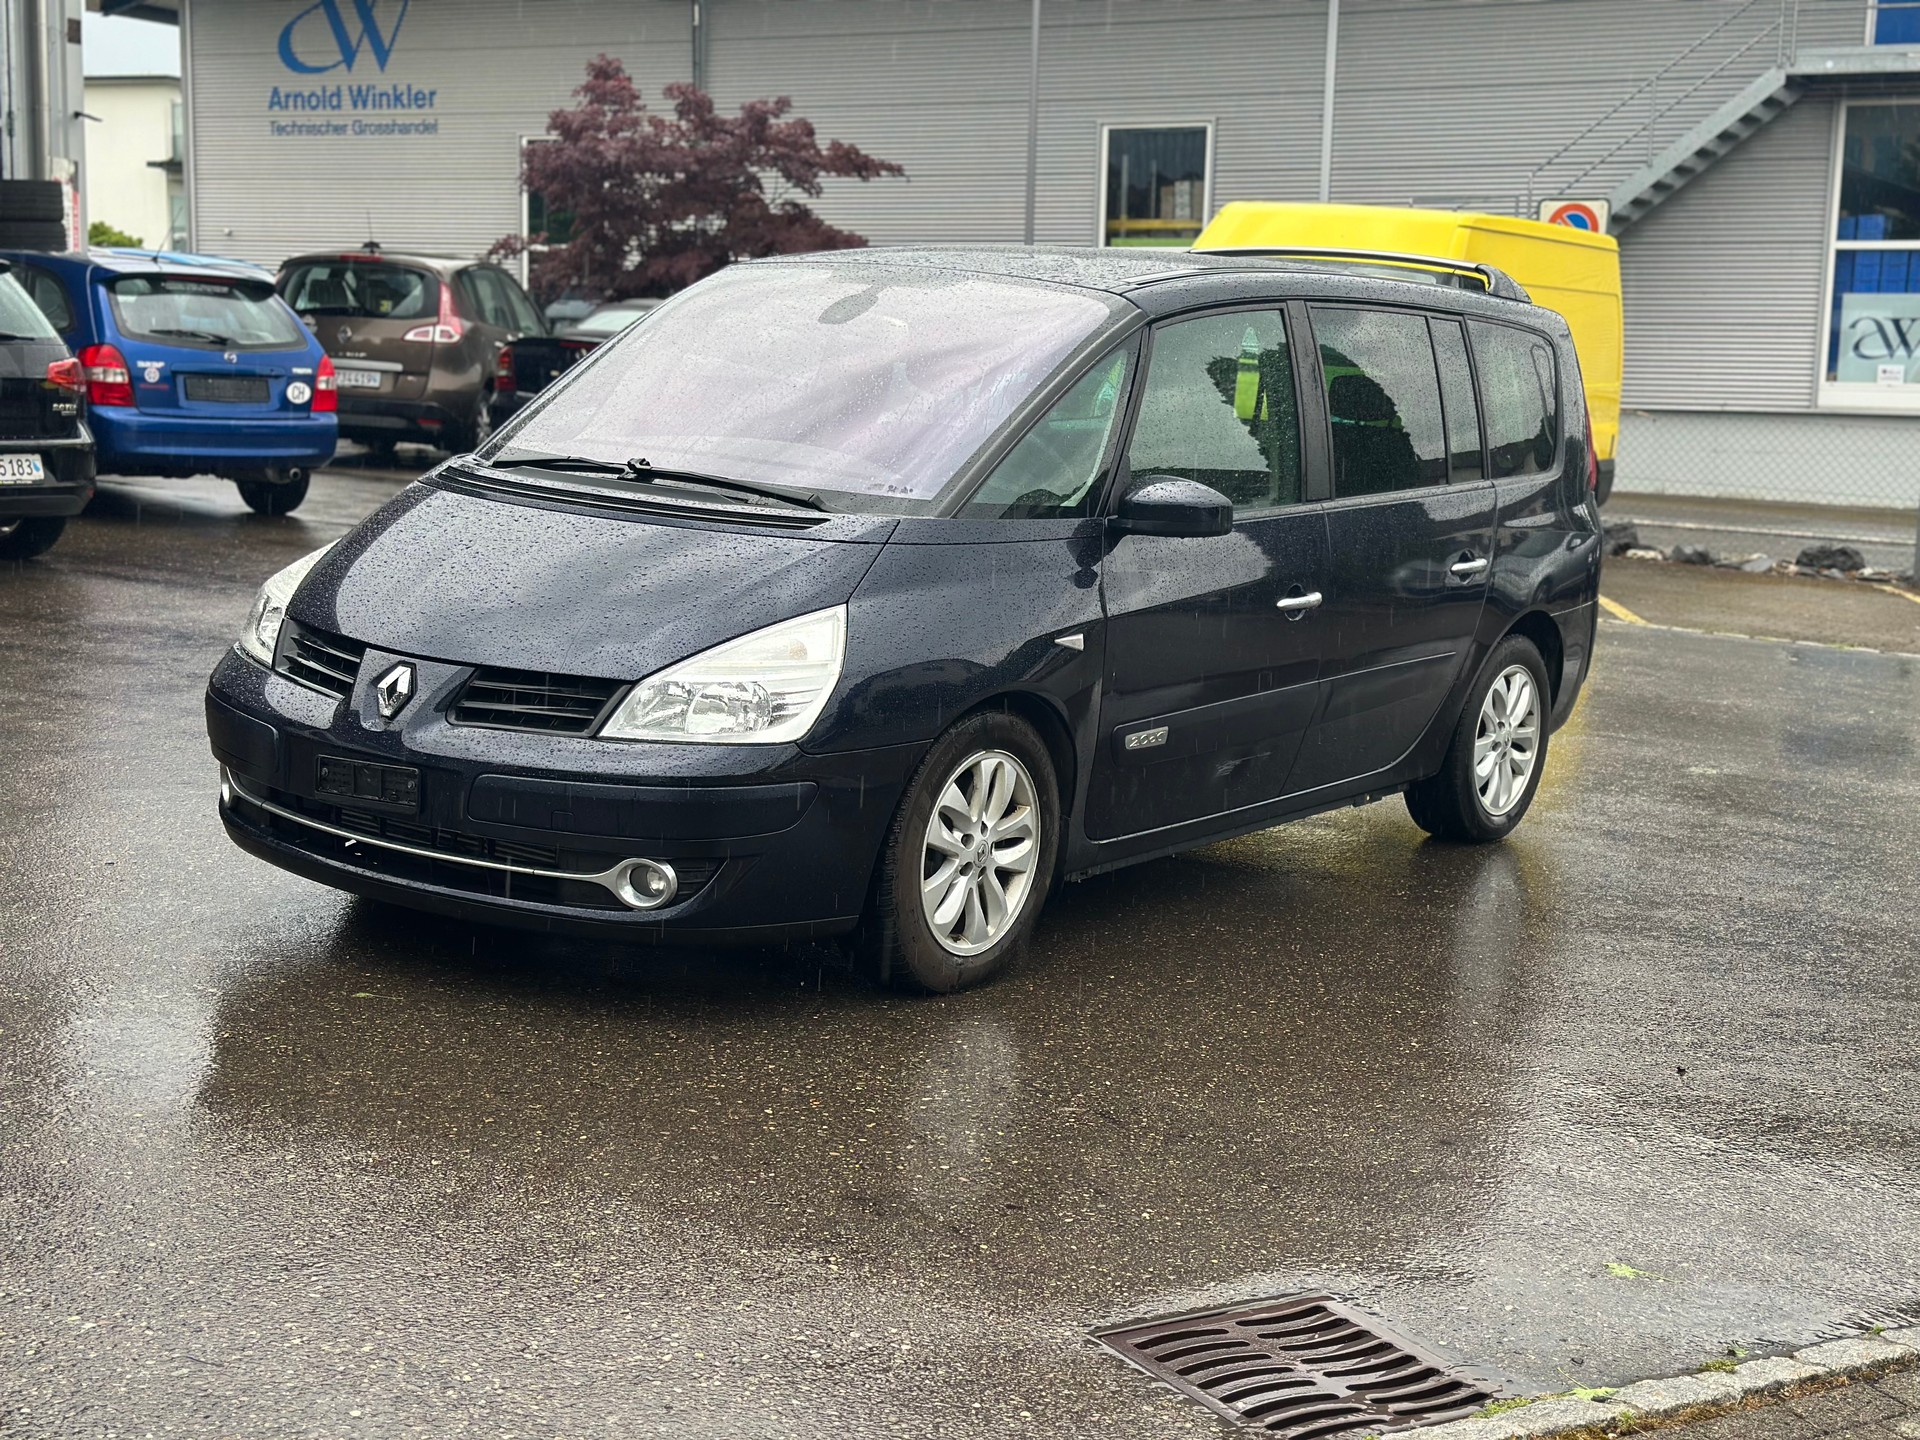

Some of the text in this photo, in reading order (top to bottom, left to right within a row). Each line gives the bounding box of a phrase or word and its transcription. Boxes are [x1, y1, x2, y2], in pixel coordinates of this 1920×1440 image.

[268, 83, 437, 111] Arnold Winkler
[269, 119, 439, 136] Technischer Grosshandel
[292, 382, 306, 399] CH
